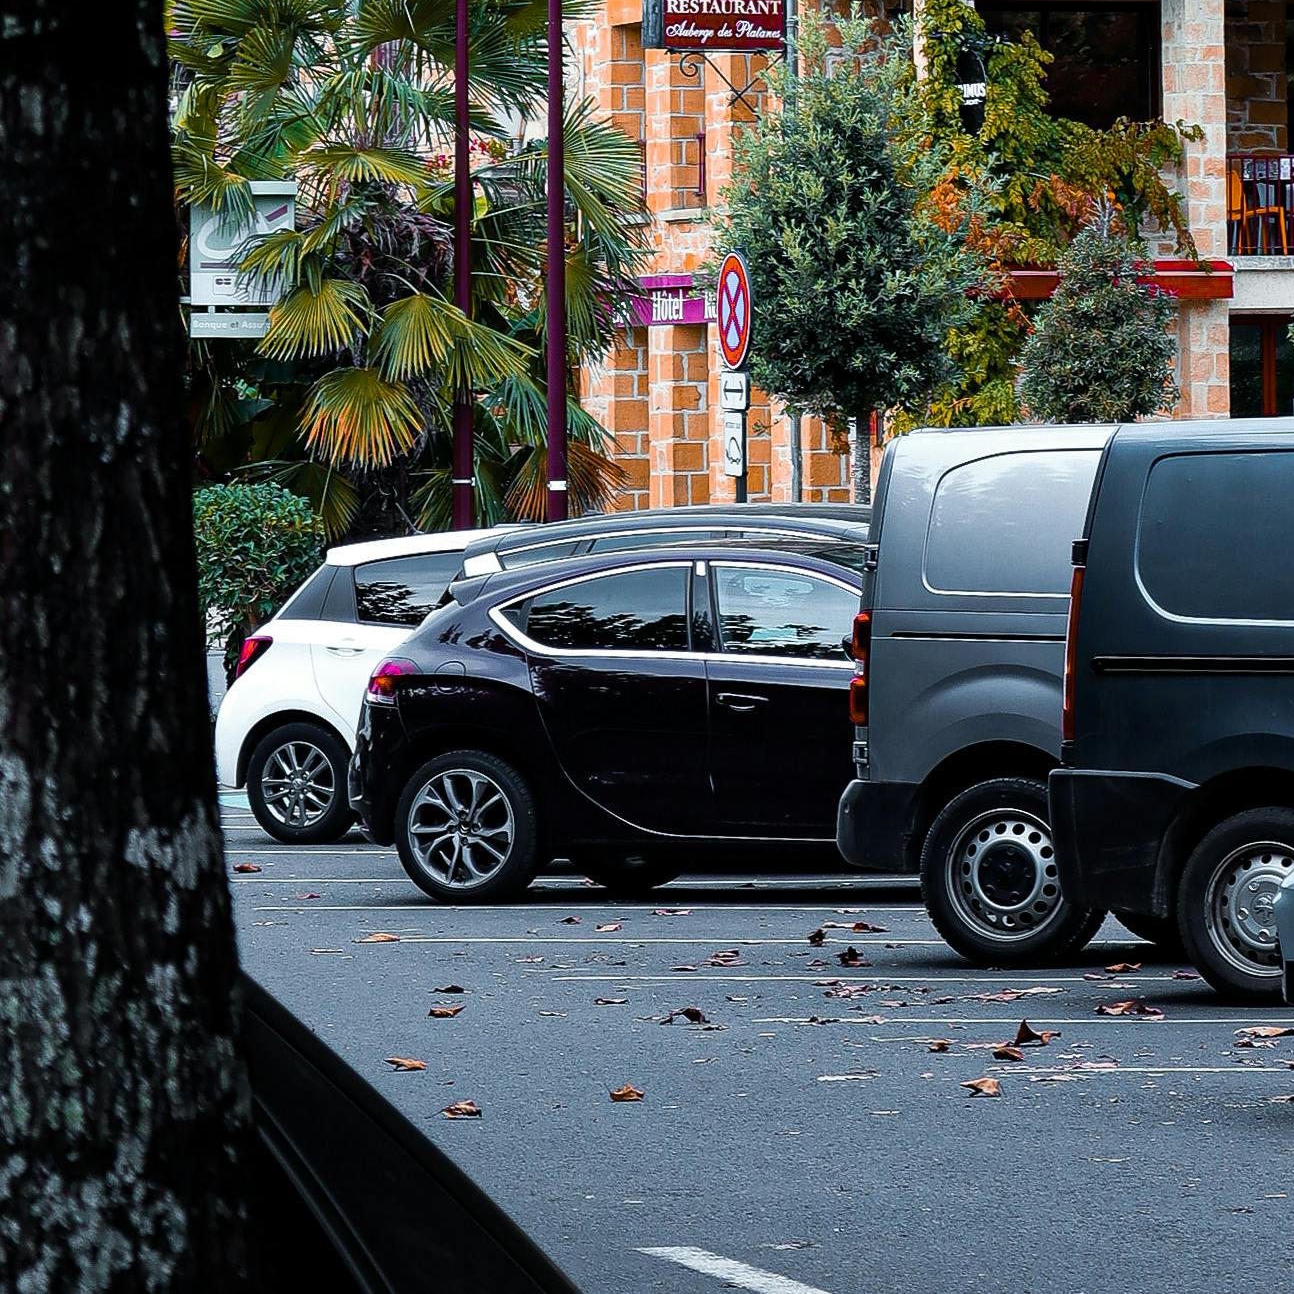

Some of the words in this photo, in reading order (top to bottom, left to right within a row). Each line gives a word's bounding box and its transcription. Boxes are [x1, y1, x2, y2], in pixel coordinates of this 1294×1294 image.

[666, 20, 714, 43] Auberge
[717, 22, 733, 38] des
[735, 20, 780, 38] Platanes
[652, 289, 684, 321] Hôtel
[192, 320, 227, 331] Banque
